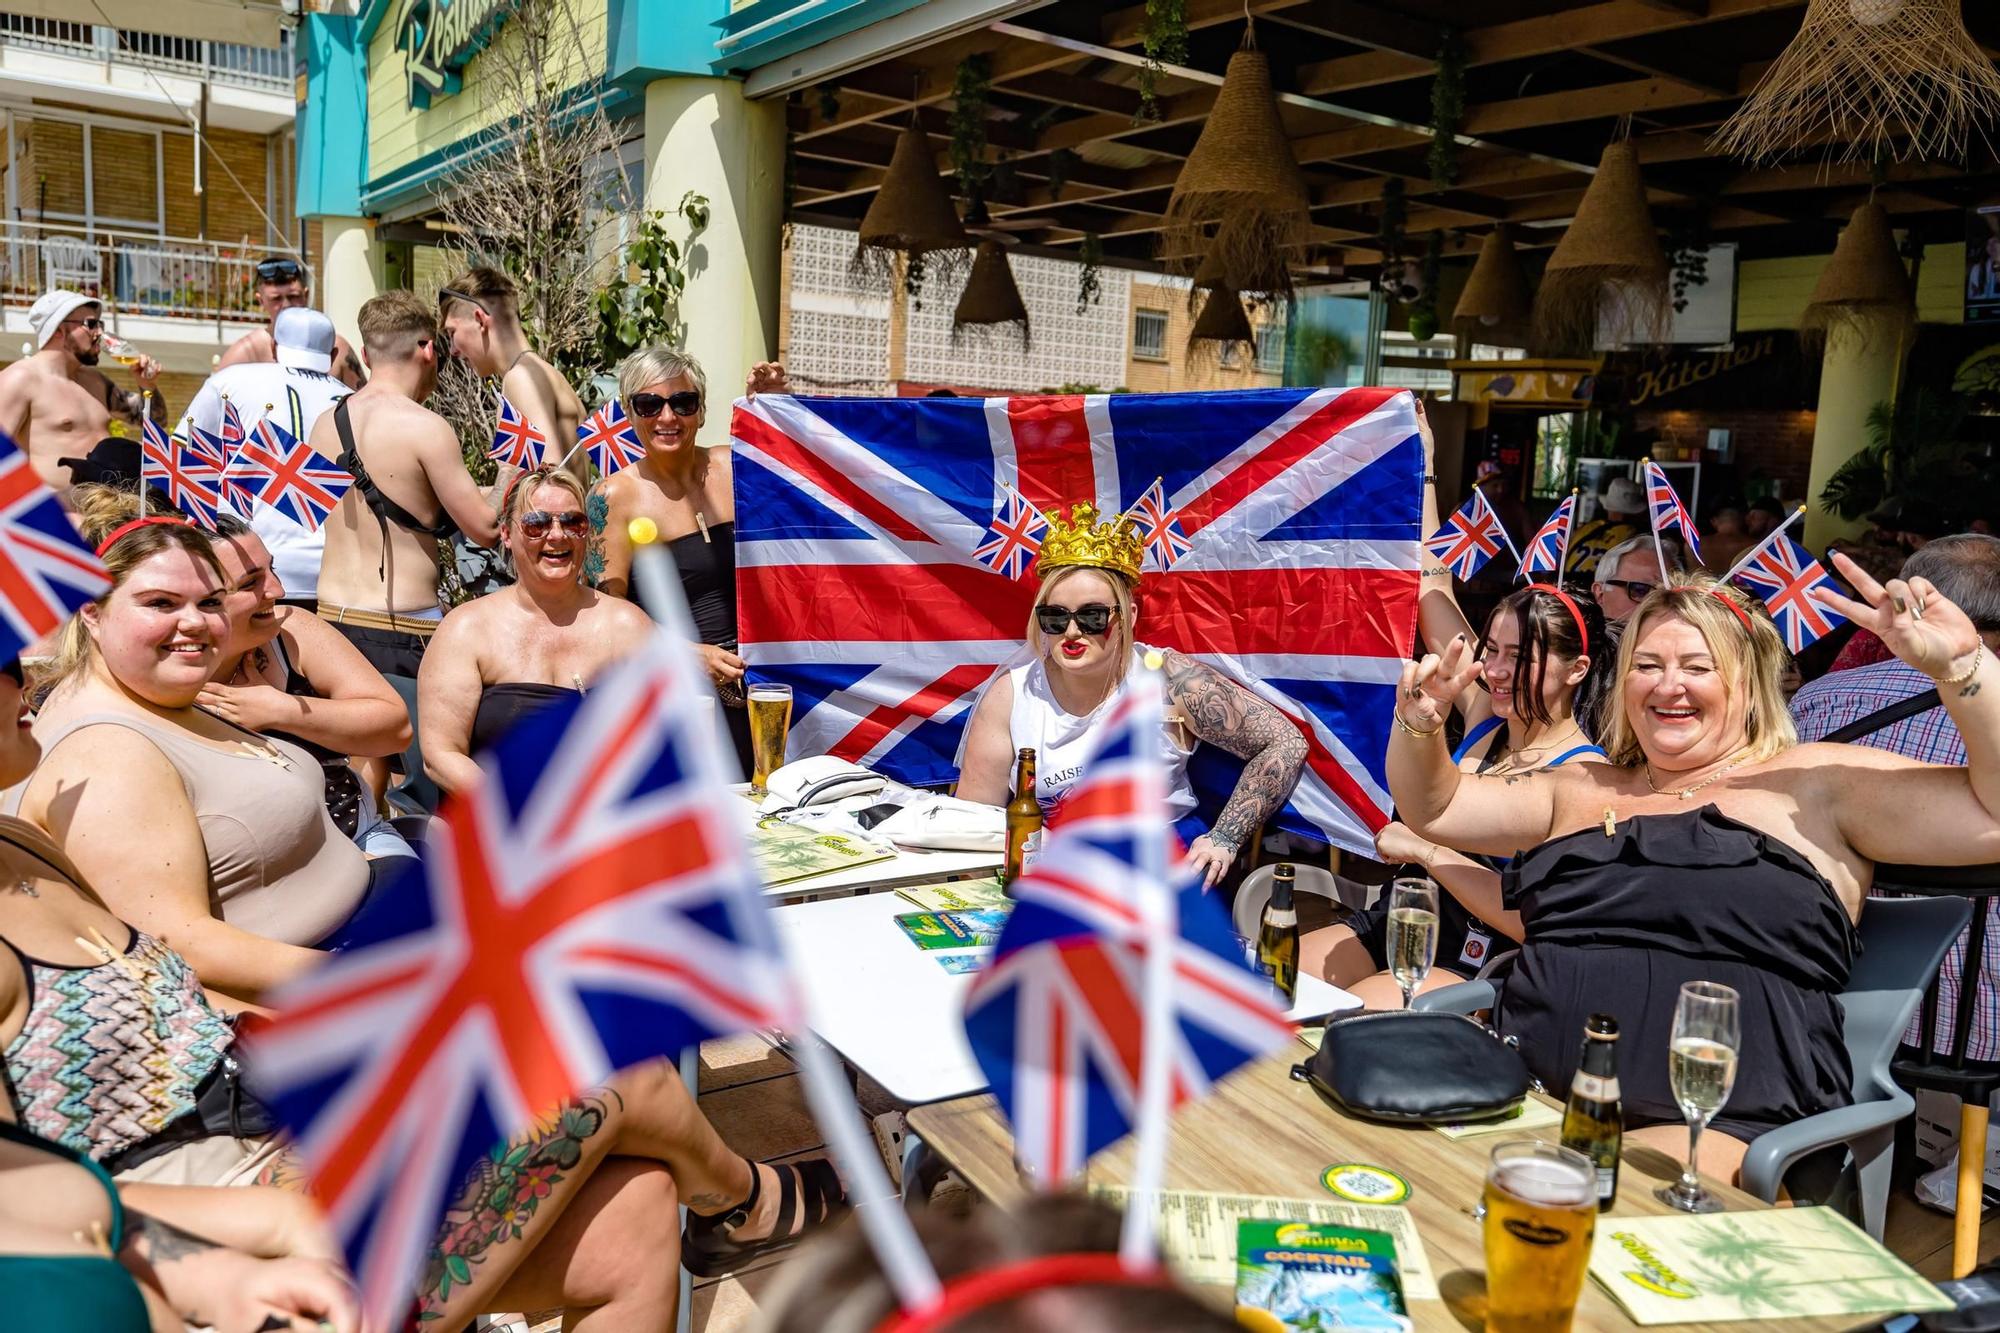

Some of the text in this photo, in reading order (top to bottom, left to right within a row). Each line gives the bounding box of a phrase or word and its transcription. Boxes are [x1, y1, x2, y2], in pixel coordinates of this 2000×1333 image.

[1629, 337, 1774, 405] Kitchen
[1043, 766, 1084, 788] RAISE
[1264, 1251, 1372, 1269] COCKTAIL
[1281, 1260, 1357, 1276] MENU
